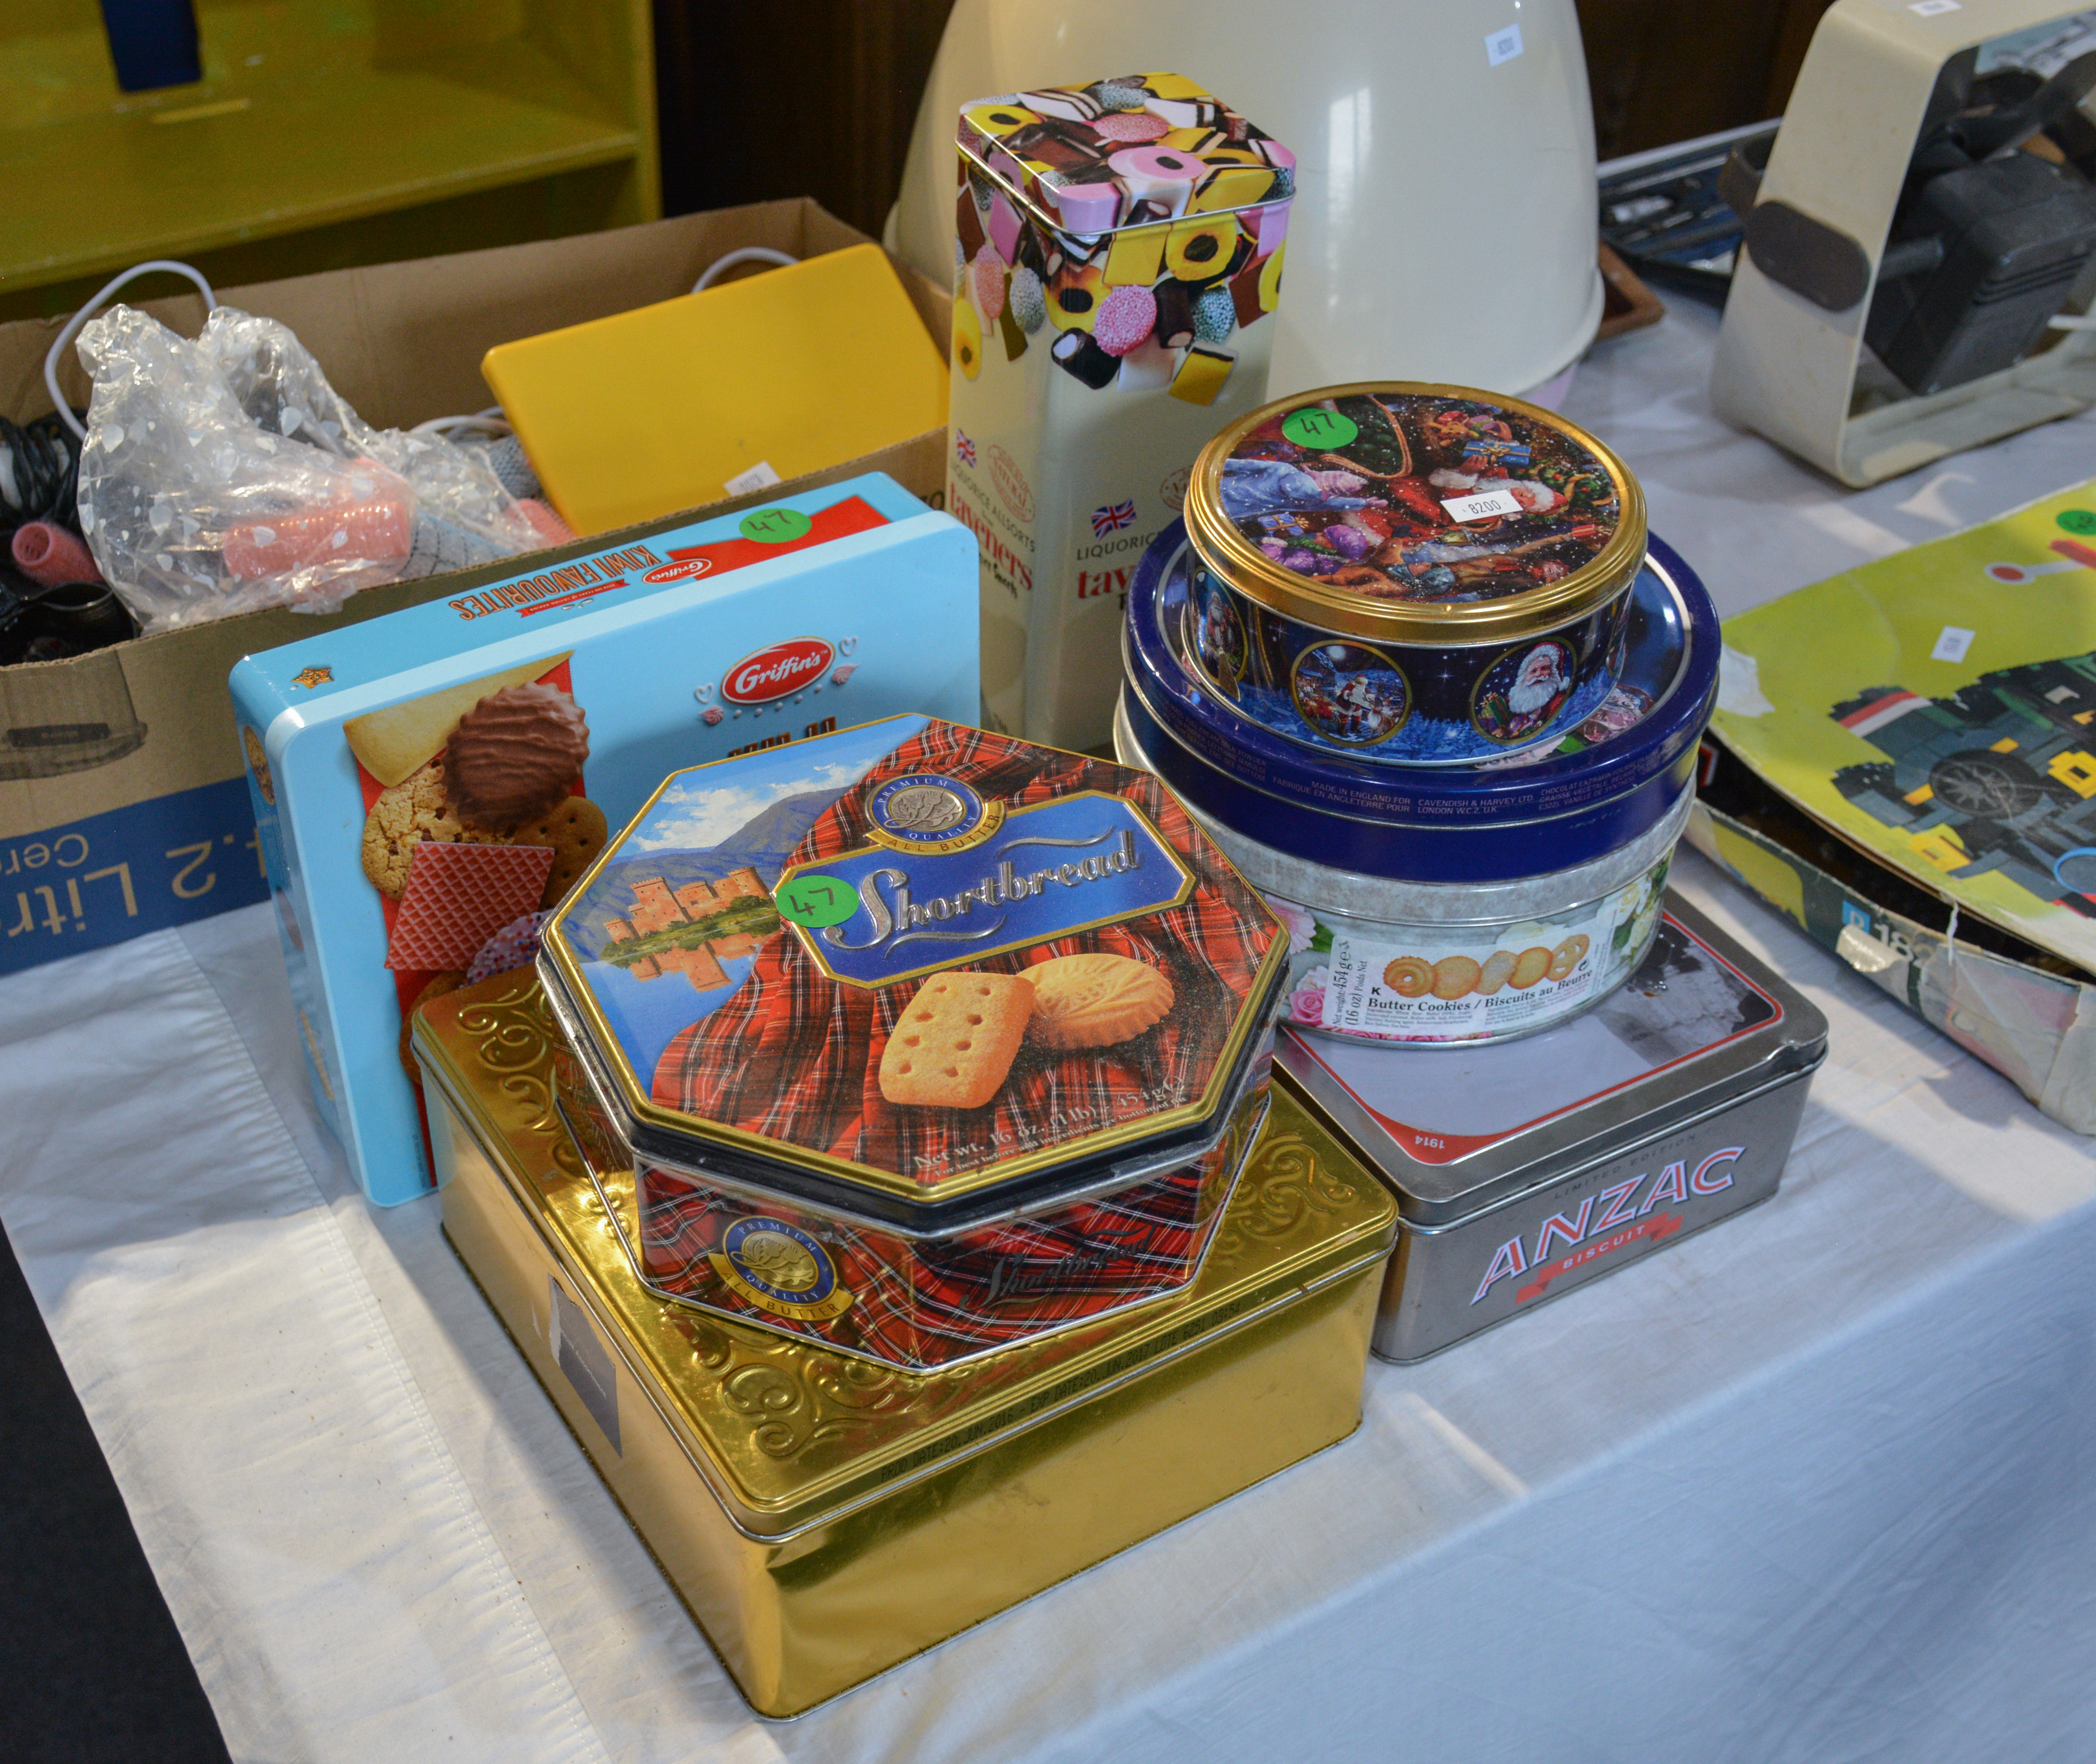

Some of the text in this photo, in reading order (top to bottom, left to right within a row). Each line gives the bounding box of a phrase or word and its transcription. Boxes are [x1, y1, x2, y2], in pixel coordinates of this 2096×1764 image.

[1300, 413, 1334, 435] 47
[748, 511, 791, 532] 47
[1468, 500, 1501, 514] 8200
[1077, 531, 1162, 560] LIQUORIC
[448, 545, 661, 620] KIWI FAVOURITES
[651, 561, 704, 581] Griffin's
[735, 652, 821, 694] Griffin's
[877, 777, 949, 804] PREMIUM
[1273, 776, 1312, 794] FABRIQUE
[1327, 793, 1384, 810] ANGLETERRE
[1386, 803, 1410, 812] POUR
[1312, 781, 1337, 793] MADE
[1350, 791, 1392, 803] ENGLAND
[1418, 799, 1469, 807] CAVENDISH
[1480, 797, 1516, 807] HARVEY
[1540, 792, 1571, 803] GRAISSE
[1541, 782, 1578, 796] CHOCOLAT
[1563, 793, 1592, 805] VANILLE
[887, 813, 1000, 852] ALL BUTTER
[909, 815, 977, 841] QUALITY
[0, 833, 89, 876] Cer
[0, 861, 138, 938] Litr
[788, 886, 835, 916] 47
[822, 829, 1141, 950] Shortbread
[1333, 970, 1349, 988] 454
[1339, 961, 1353, 971] g
[1345, 960, 1368, 1026] (16 oz) Poids Net
[1368, 997, 1414, 1011] Butter
[1418, 1001, 1471, 1011] Cookies
[1484, 989, 1535, 1008] Biscuits
[1539, 986, 1553, 996] au
[1557, 969, 1593, 991] Beurre
[1371, 987, 1382, 995] K
[1332, 1014, 1342, 1026] Net
[913, 1151, 950, 1169] Net
[954, 1142, 985, 1157] wt.
[990, 1129, 1012, 1146] 16
[1116, 1088, 1150, 1107] 454
[935, 1167, 955, 1177] For
[957, 1158, 980, 1170] best
[981, 1147, 1017, 1162] before
[1041, 1122, 1100, 1145] ingredients
[1118, 1106, 1156, 1121] bottom
[1157, 1101, 1169, 1109] of
[1415, 1135, 1445, 1149] 1914
[1555, 1134, 1697, 1199] LIMITED EDITION
[738, 1221, 817, 1252] PREMIUM
[1470, 1146, 1747, 1306] ANZAC
[1563, 1224, 1646, 1270] BISCUIT
[959, 1223, 1158, 1311] Shortbread
[721, 1272, 840, 1319] ALL BUTTER
[746, 1275, 820, 1301] QUALITY
[881, 1458, 908, 1483] PROD
[1030, 1392, 1050, 1413] EXP
